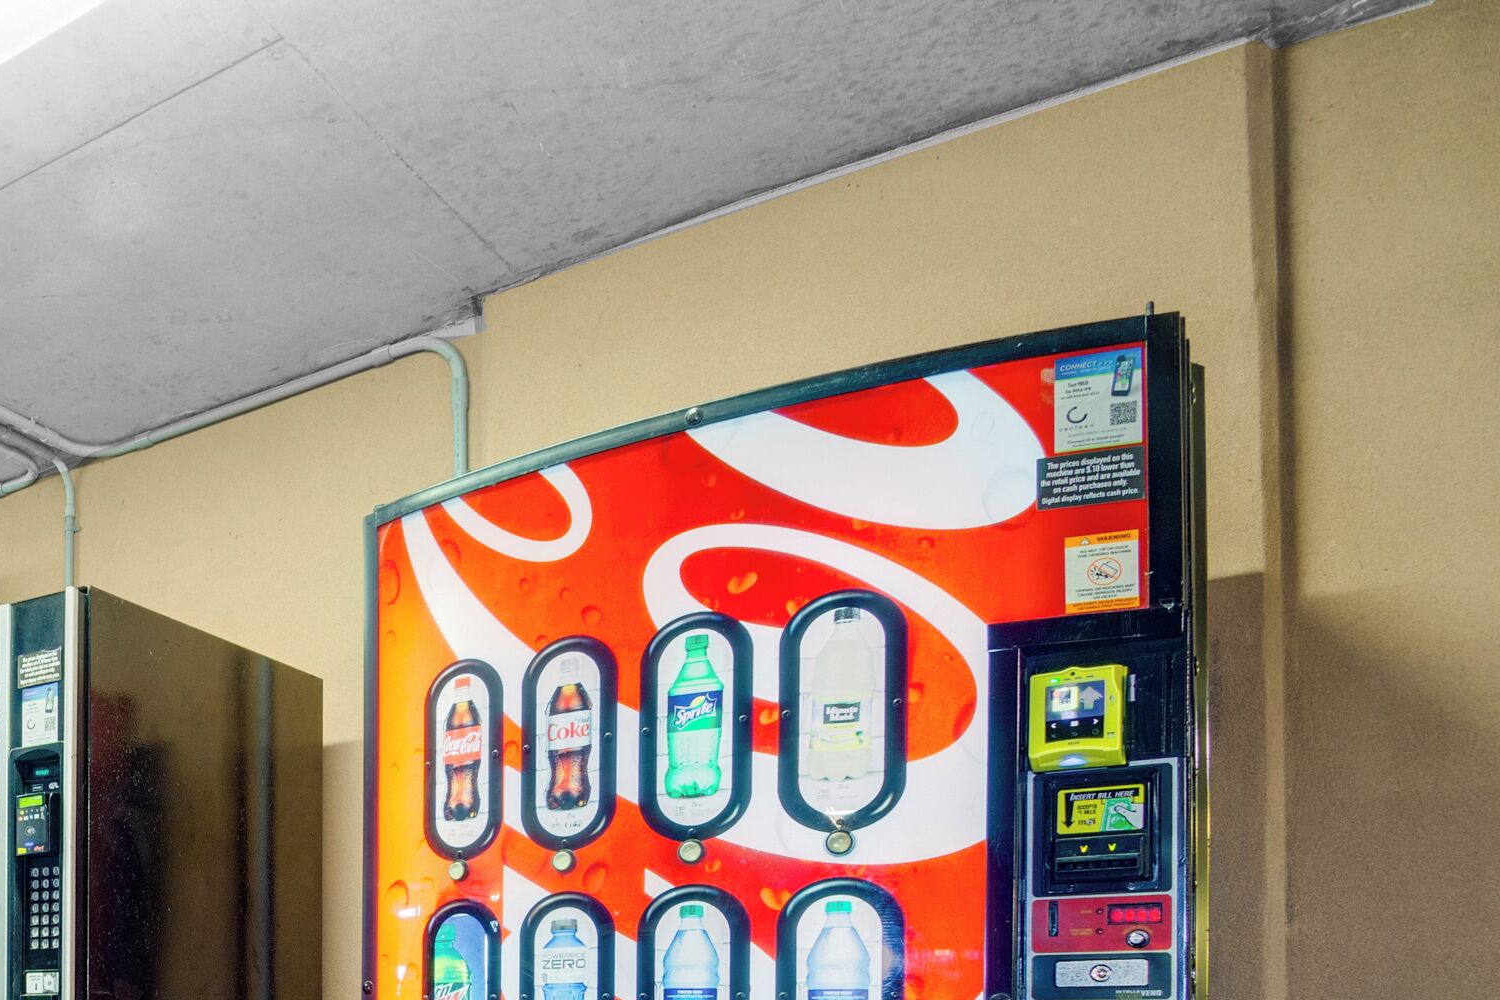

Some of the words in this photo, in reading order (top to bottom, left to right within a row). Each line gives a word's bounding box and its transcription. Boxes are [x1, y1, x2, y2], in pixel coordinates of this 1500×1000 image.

[1060, 361, 1097, 372] CONNECT
[1060, 460, 1079, 469] prices
[1081, 455, 1111, 466] displayed
[1046, 469, 1073, 478] machine
[1086, 466, 1100, 474] $.10
[1101, 463, 1119, 472] lower
[1052, 477, 1068, 486] retail
[1069, 475, 1085, 485] price
[1087, 473, 1099, 482] and
[1112, 469, 1140, 478] available
[1063, 484, 1077, 492] cash
[1079, 481, 1111, 492] purchases
[1113, 479, 1128, 487] only.
[1042, 496, 1060, 505] Digital
[1061, 494, 1082, 503] display
[1122, 488, 1139, 496] price.
[1096, 533, 1130, 542] WARNING
[675, 700, 714, 725] Sprite
[826, 706, 858, 714] Minute
[548, 722, 590, 742] Coke
[1070, 792, 1096, 801] INSERT
[542, 959, 586, 969] ZERO
